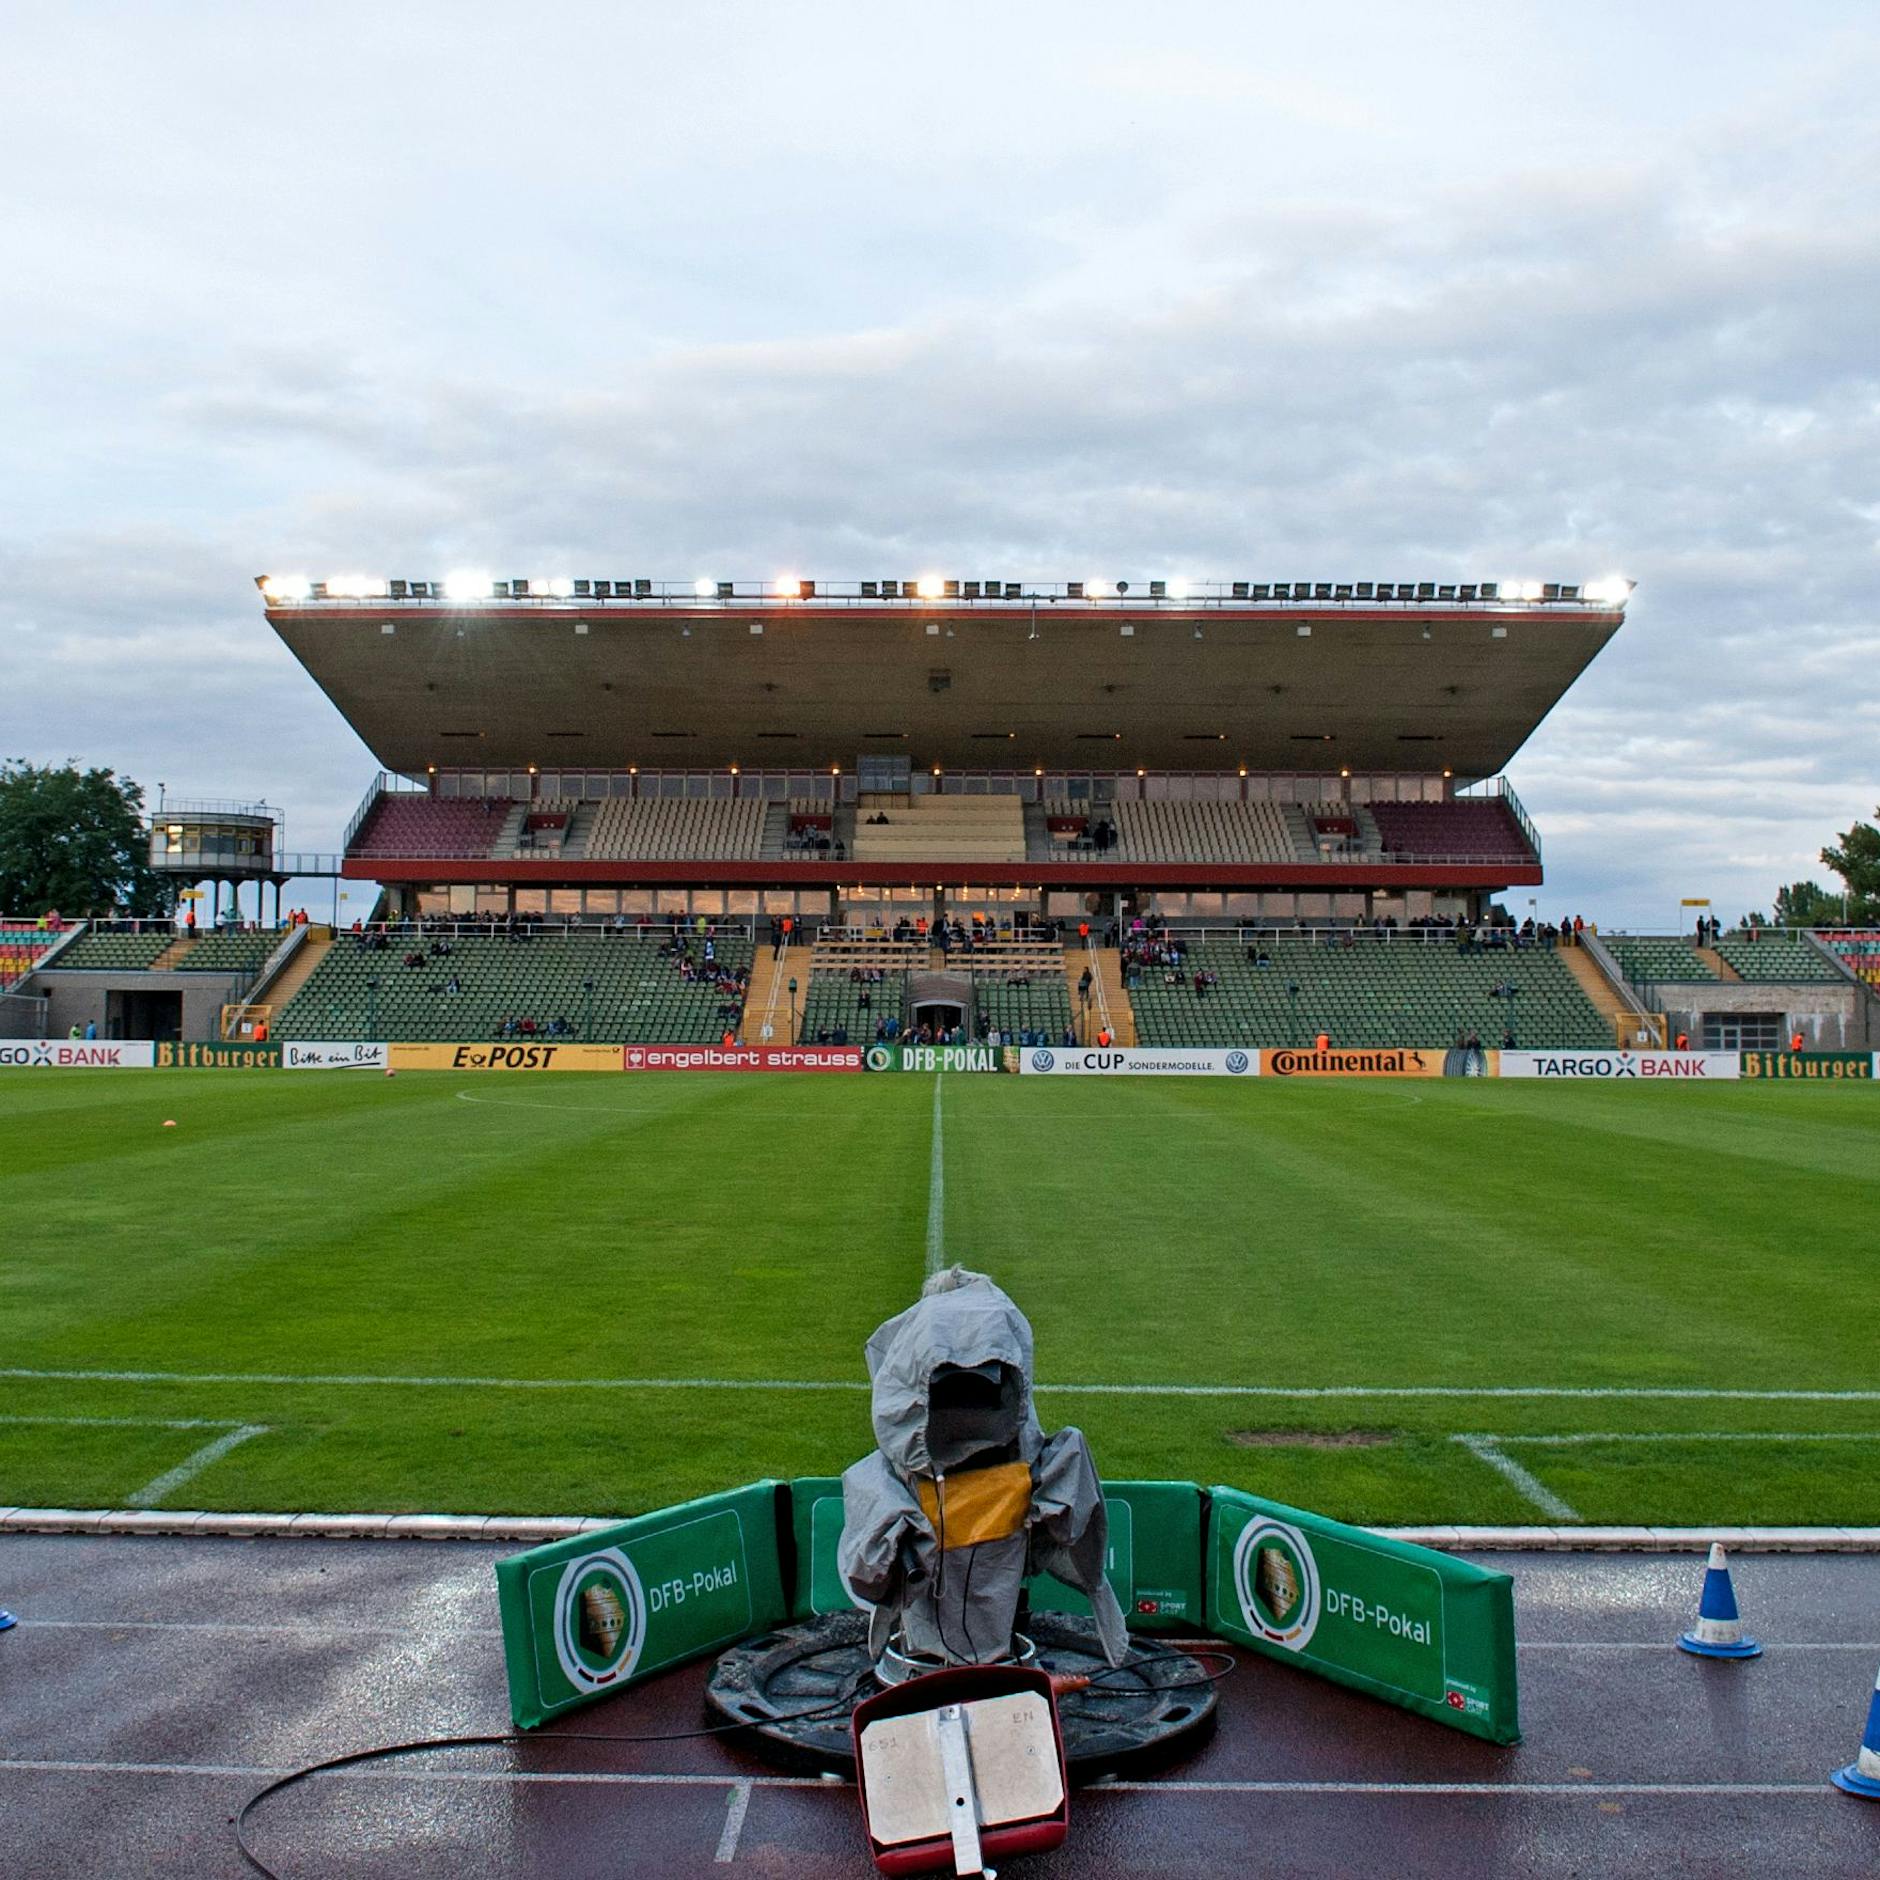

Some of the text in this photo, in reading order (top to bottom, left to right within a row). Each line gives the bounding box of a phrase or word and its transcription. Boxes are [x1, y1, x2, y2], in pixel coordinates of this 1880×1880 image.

[58, 1048, 121, 1065] BANK
[157, 1042, 279, 1068] Bitburger
[290, 1045, 383, 1065] Bitte ein Bit
[647, 1049, 859, 1068] engelbert strauss
[902, 1047, 998, 1072] DFB-POKAL
[1065, 1061, 1081, 1070] DIE
[1083, 1053, 1125, 1070] CUP
[1271, 1050, 1406, 1075] Continental
[1532, 1058, 1706, 1076] TARGO BANK
[1745, 1052, 1868, 1078] Bitburger
[649, 1560, 738, 1613] DFB-Pokal
[1326, 1588, 1431, 1646] DFB-Pokal
